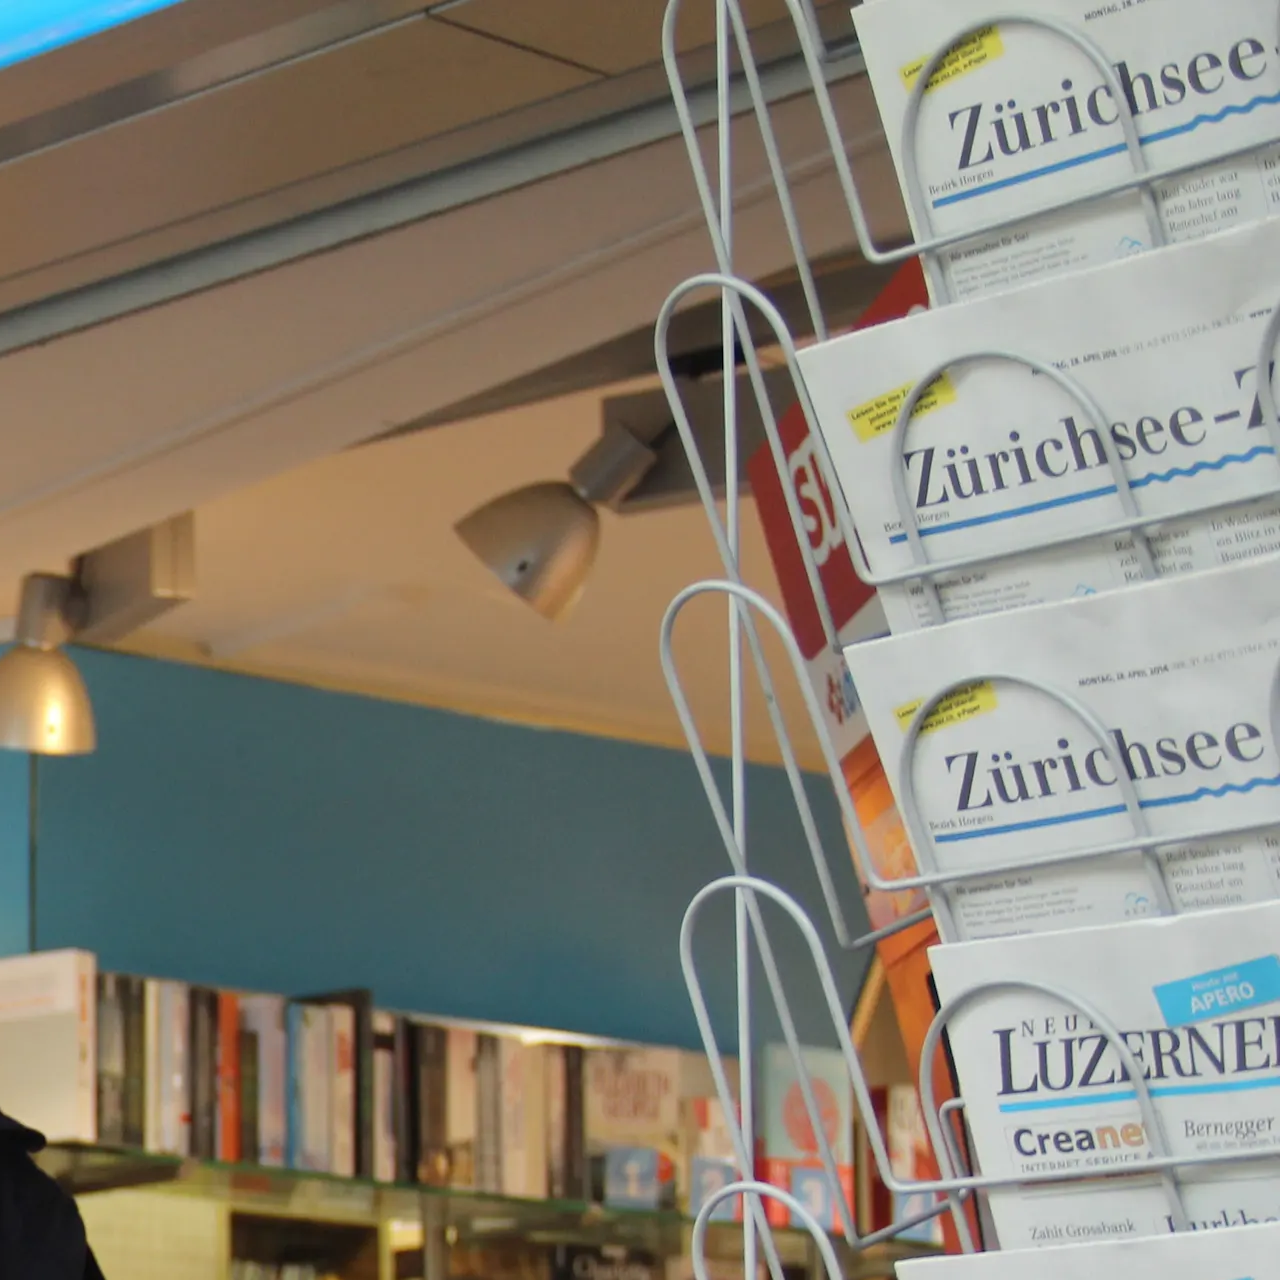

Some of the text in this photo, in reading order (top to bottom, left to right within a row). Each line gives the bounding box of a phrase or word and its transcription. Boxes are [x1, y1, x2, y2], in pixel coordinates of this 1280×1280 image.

[944, 719, 1265, 812] Zürichsee
[1190, 981, 1255, 1014] APERO
[1020, 1013, 1103, 1038] NEU
[1013, 1115, 1275, 1157] Creane Bernegger
[1020, 1157, 1081, 1174] INTERNET
[1066, 1219, 1138, 1239] Grossbank
